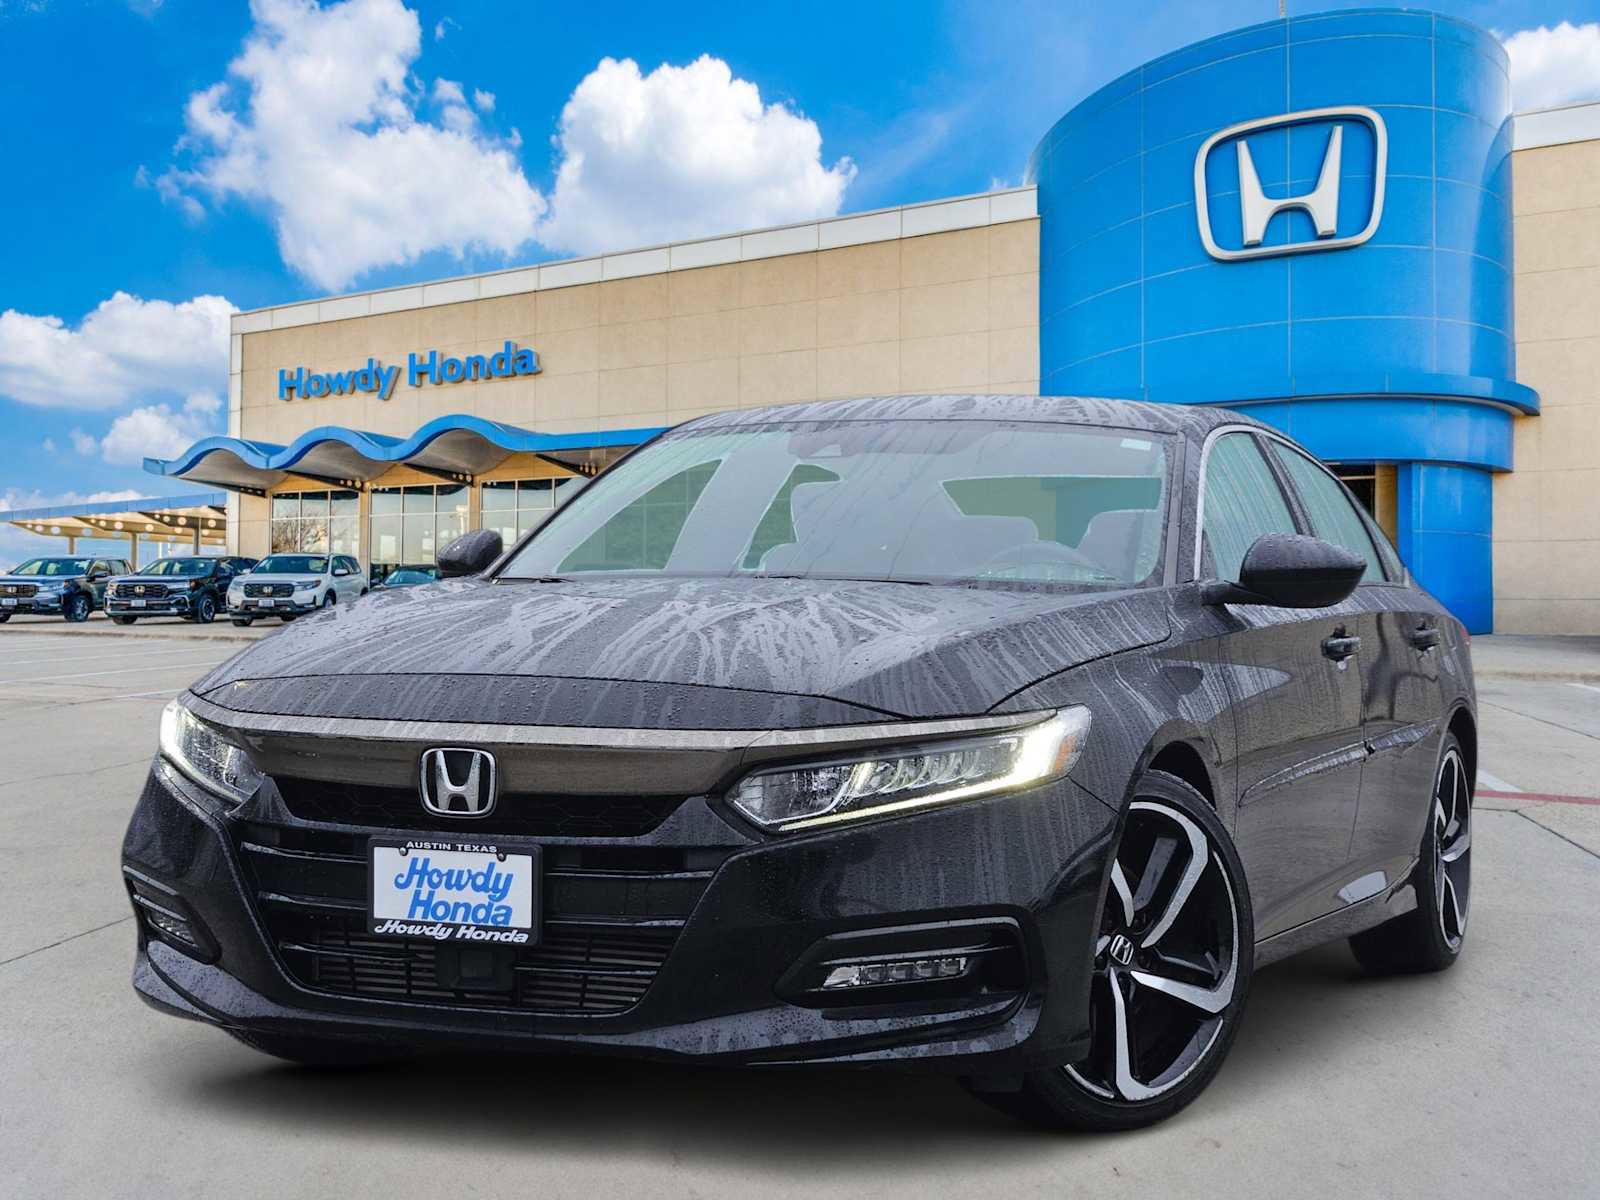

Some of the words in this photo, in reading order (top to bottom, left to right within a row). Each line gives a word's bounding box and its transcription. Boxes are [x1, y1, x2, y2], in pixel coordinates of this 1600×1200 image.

[278, 358, 401, 401] Howdy
[407, 340, 542, 387] Honda
[405, 840, 451, 850] AUSTIN
[456, 843, 498, 853] TEXAS
[394, 857, 513, 902] Howdy
[407, 889, 513, 926] Honda
[374, 920, 453, 940] Howdy
[456, 926, 529, 943] Honda
